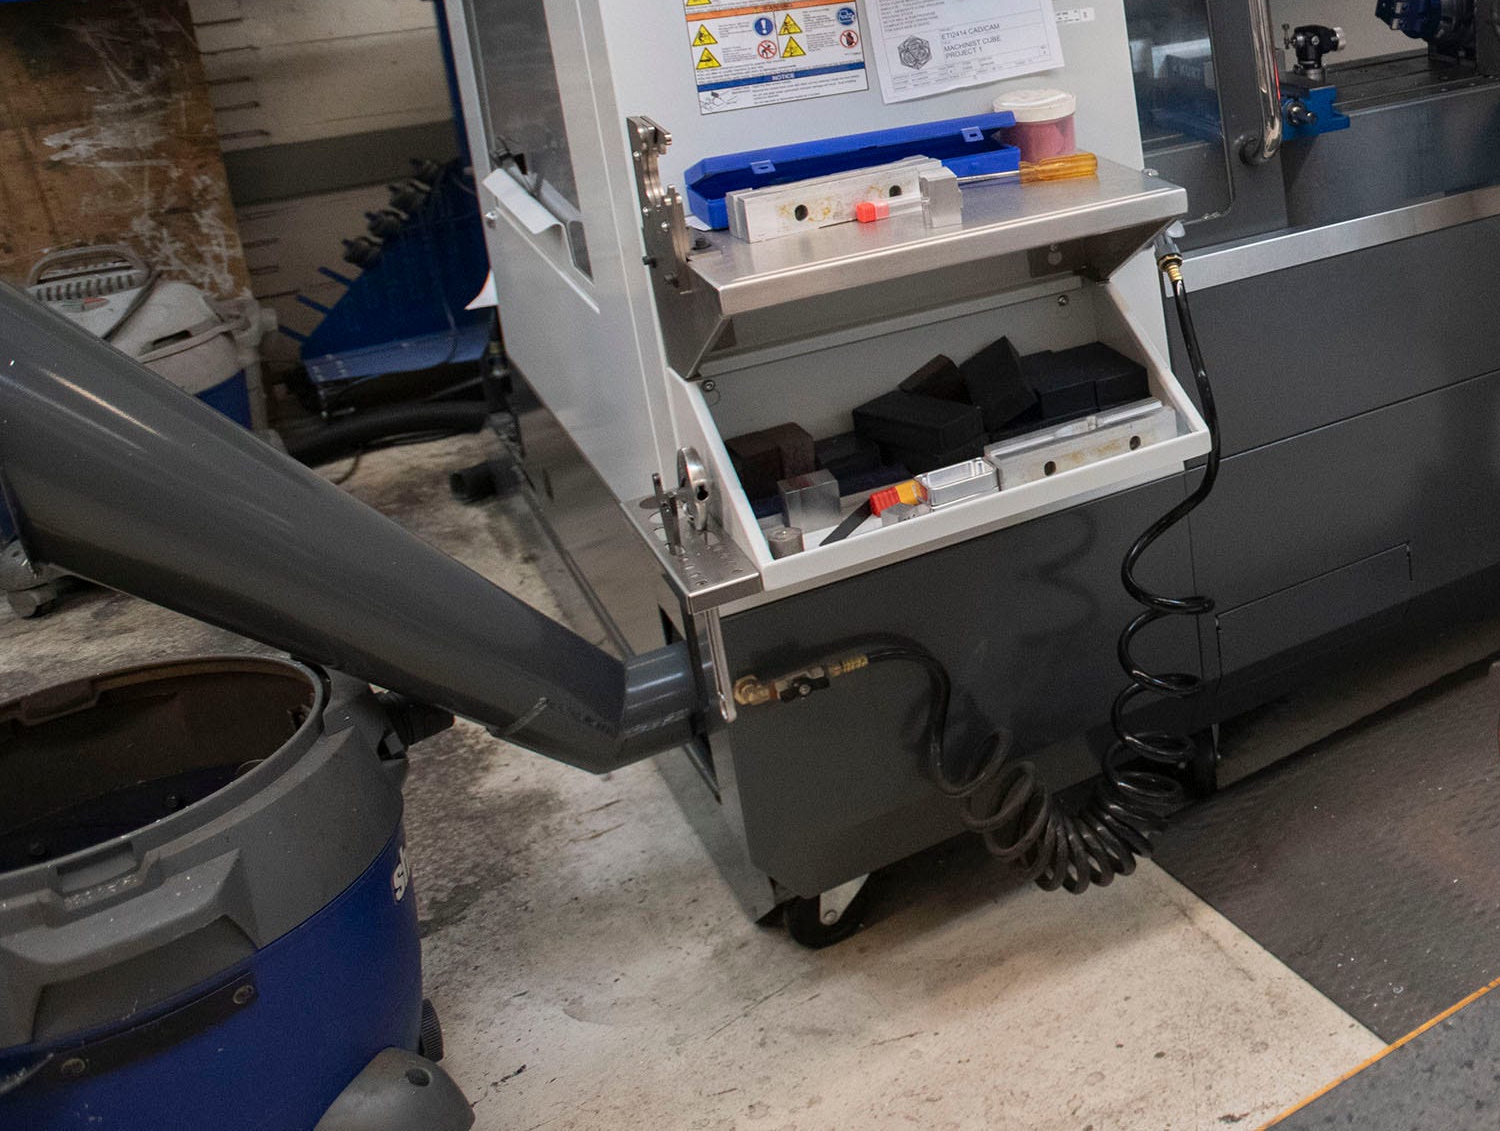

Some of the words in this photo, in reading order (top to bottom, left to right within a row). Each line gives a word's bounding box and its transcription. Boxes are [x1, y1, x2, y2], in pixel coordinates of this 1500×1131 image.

[944, 39, 982, 51] MACHINIST
[983, 36, 1001, 44] CUBE
[945, 48, 977, 59] PROJECT
